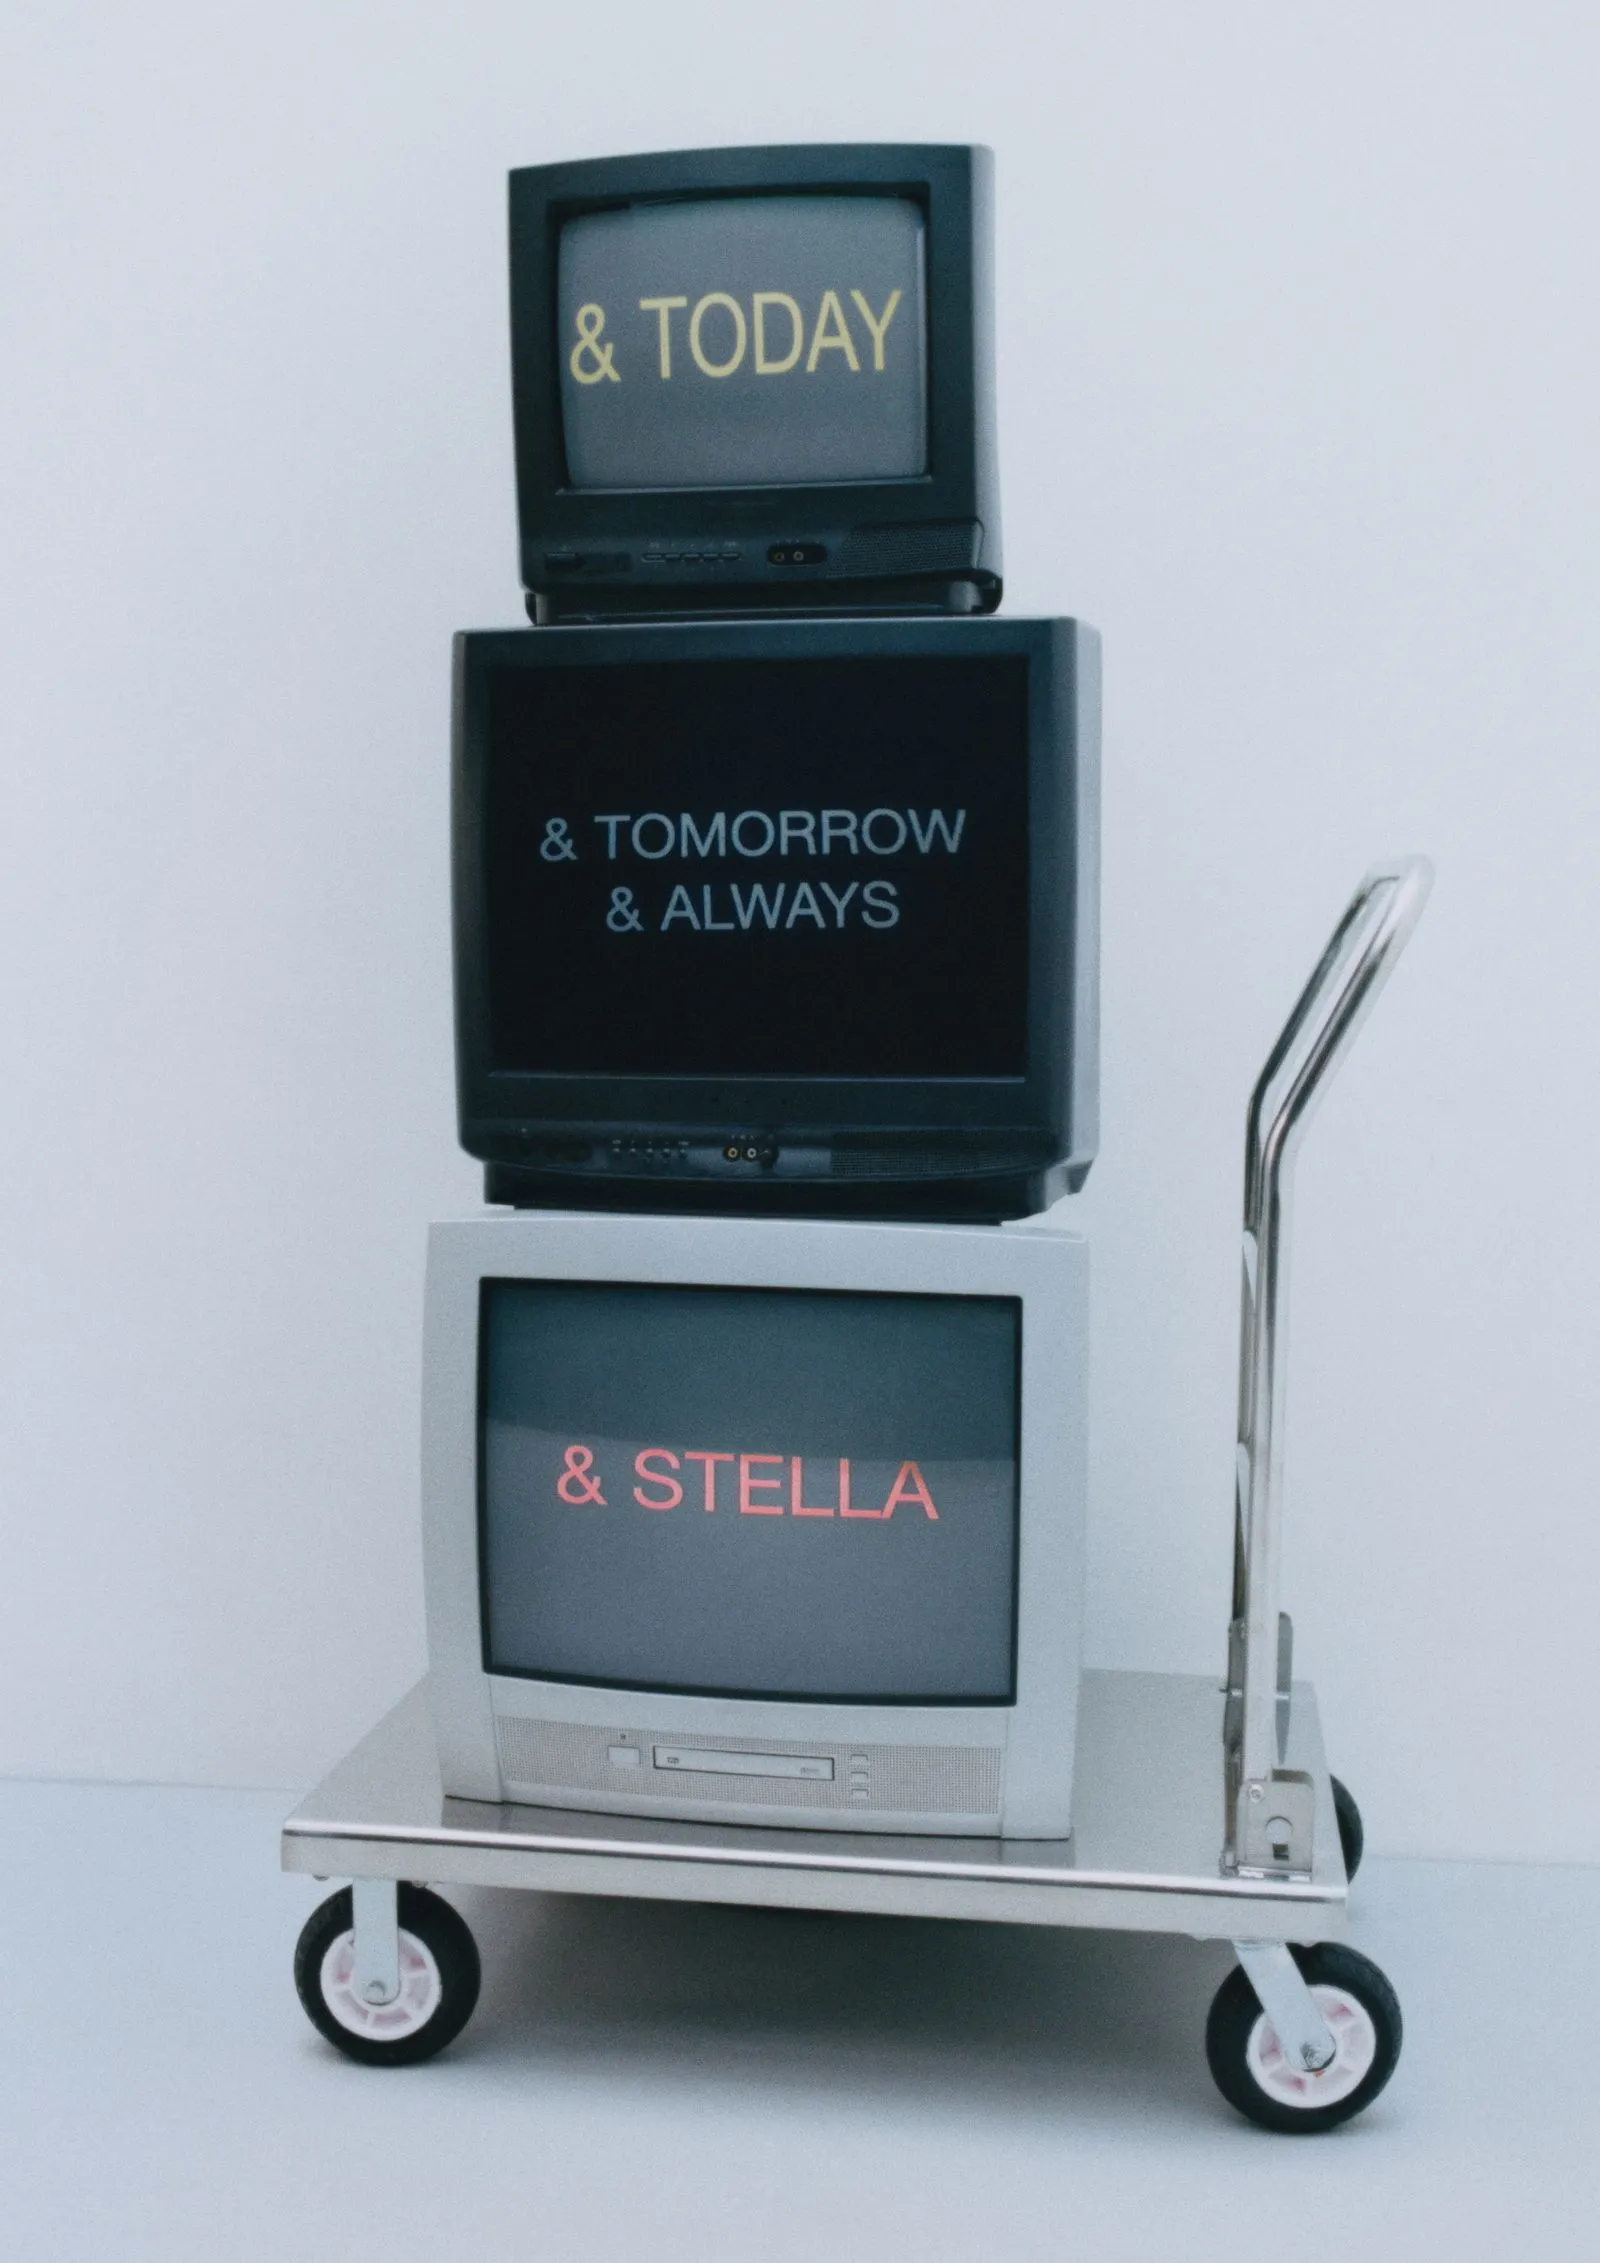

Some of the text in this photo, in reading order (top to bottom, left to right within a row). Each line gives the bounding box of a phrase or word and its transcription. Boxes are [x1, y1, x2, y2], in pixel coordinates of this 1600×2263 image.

[570, 288, 902, 385] & TODAY
[540, 807, 966, 861] & TOMORROW
[606, 880, 900, 932] & ALWAYS
[557, 1445, 938, 1520] & STELLA
